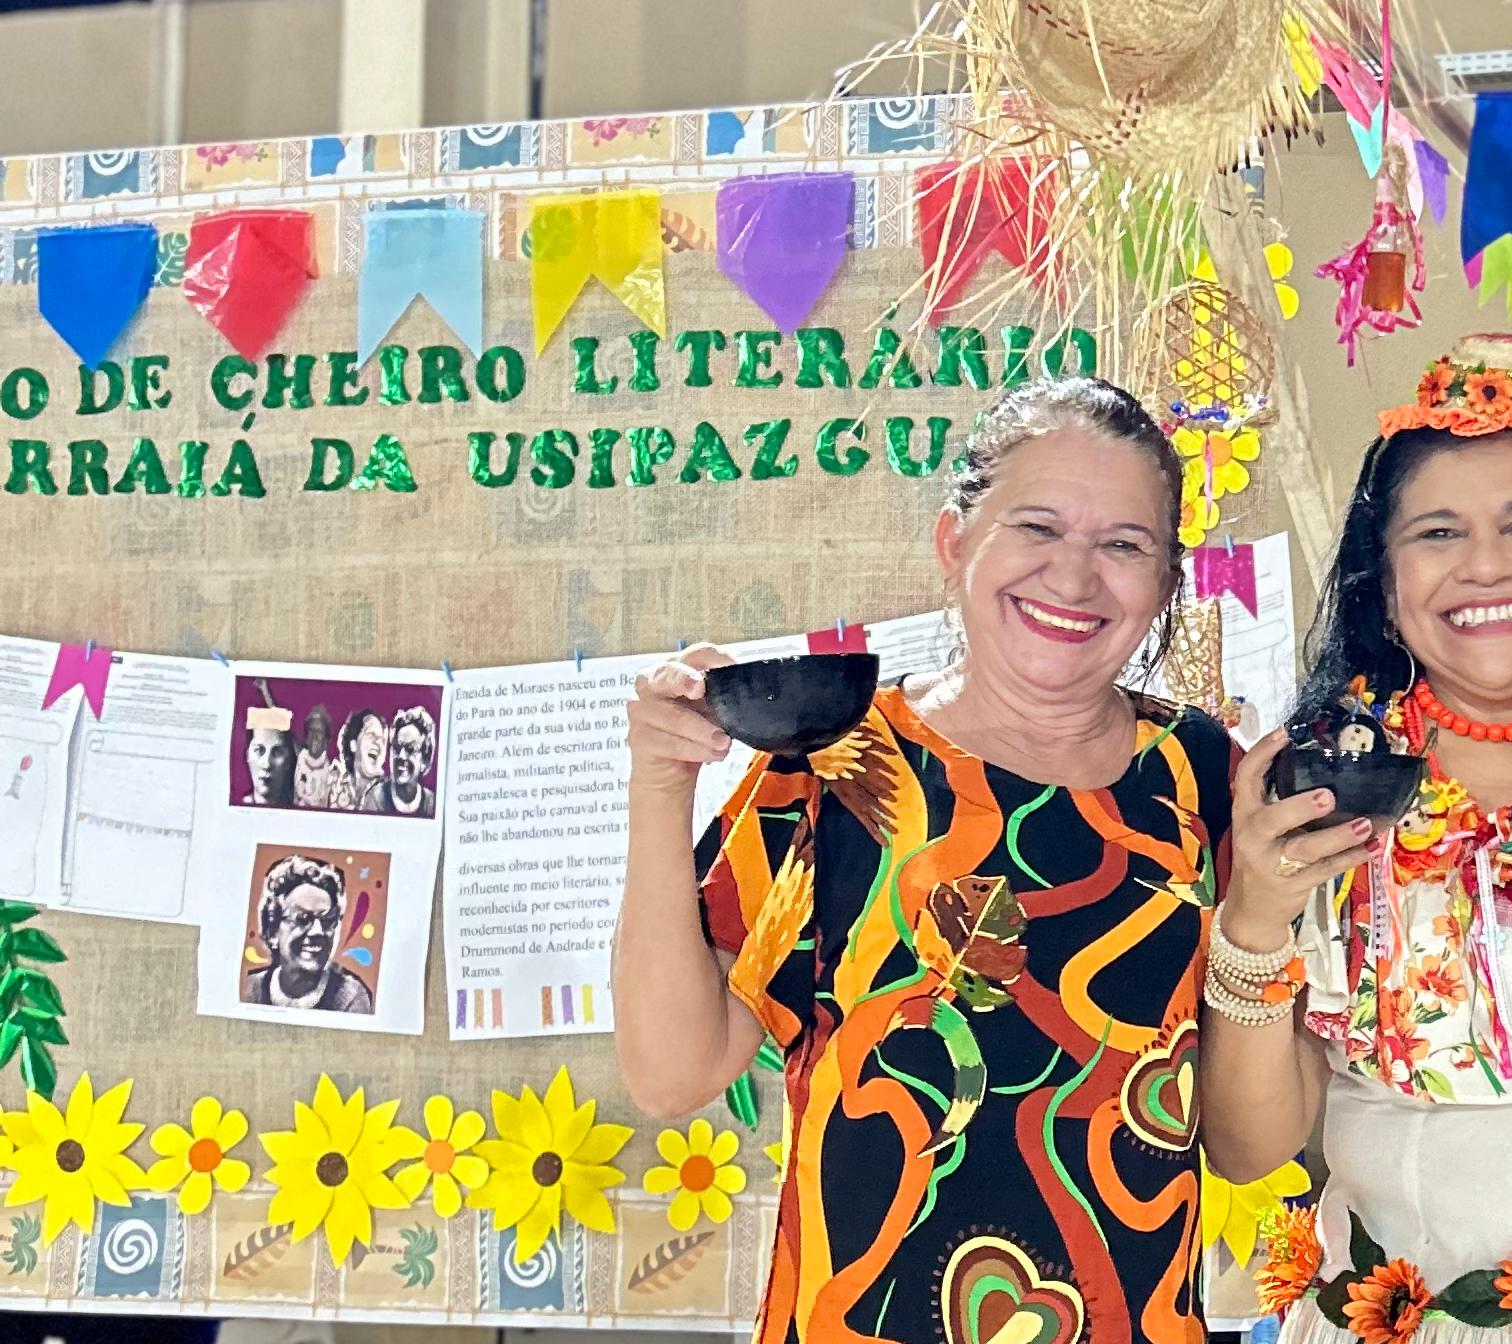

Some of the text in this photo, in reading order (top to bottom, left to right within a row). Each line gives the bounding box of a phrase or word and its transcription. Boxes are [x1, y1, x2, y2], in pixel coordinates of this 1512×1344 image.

[75, 355, 172, 416] DE
[210, 344, 526, 412] CHEIRO
[568, 297, 1098, 395] LITERÁRIO
[4, 411, 267, 499] RRAIÁ
[302, 434, 418, 493] DA
[495, 683, 507, 696] de
[559, 678, 596, 691] nasceu
[600, 677, 615, 688] em
[456, 707, 468, 720] do
[499, 706, 513, 716] no
[517, 704, 537, 714] ano
[541, 700, 554, 713] de
[559, 699, 586, 712] 1904
[590, 701, 596, 710] e
[495, 726, 523, 741] parte
[528, 721, 540, 735] da
[545, 723, 563, 733] sua
[568, 718, 591, 732] vida
[595, 719, 608, 729] no
[537, 743, 550, 756] de
[606, 737, 620, 749] foi
[531, 787, 537, 797] e
[459, 810, 478, 823] Sua
[523, 807, 546, 821] pelo
[550, 801, 597, 816] carnaval
[601, 803, 607, 812] e
[459, 831, 478, 844] não
[482, 828, 498, 842] lhe
[502, 826, 563, 841] abandonou
[568, 824, 581, 835] na
[459, 862, 506, 875] diversas
[509, 858, 538, 871] obras
[543, 858, 563, 872] que
[567, 855, 584, 869] lhe
[459, 881, 509, 896] influente
[513, 882, 527, 892] no
[531, 879, 559, 891] meio
[459, 896, 610, 916] reconhecida por escritores
[459, 922, 528, 937] modernistas
[532, 922, 545, 932] no
[549, 917, 593, 934] período
[461, 942, 526, 958] Drummond
[529, 940, 542, 953] de
[546, 937, 594, 953] Andrade
[598, 940, 605, 949] e
